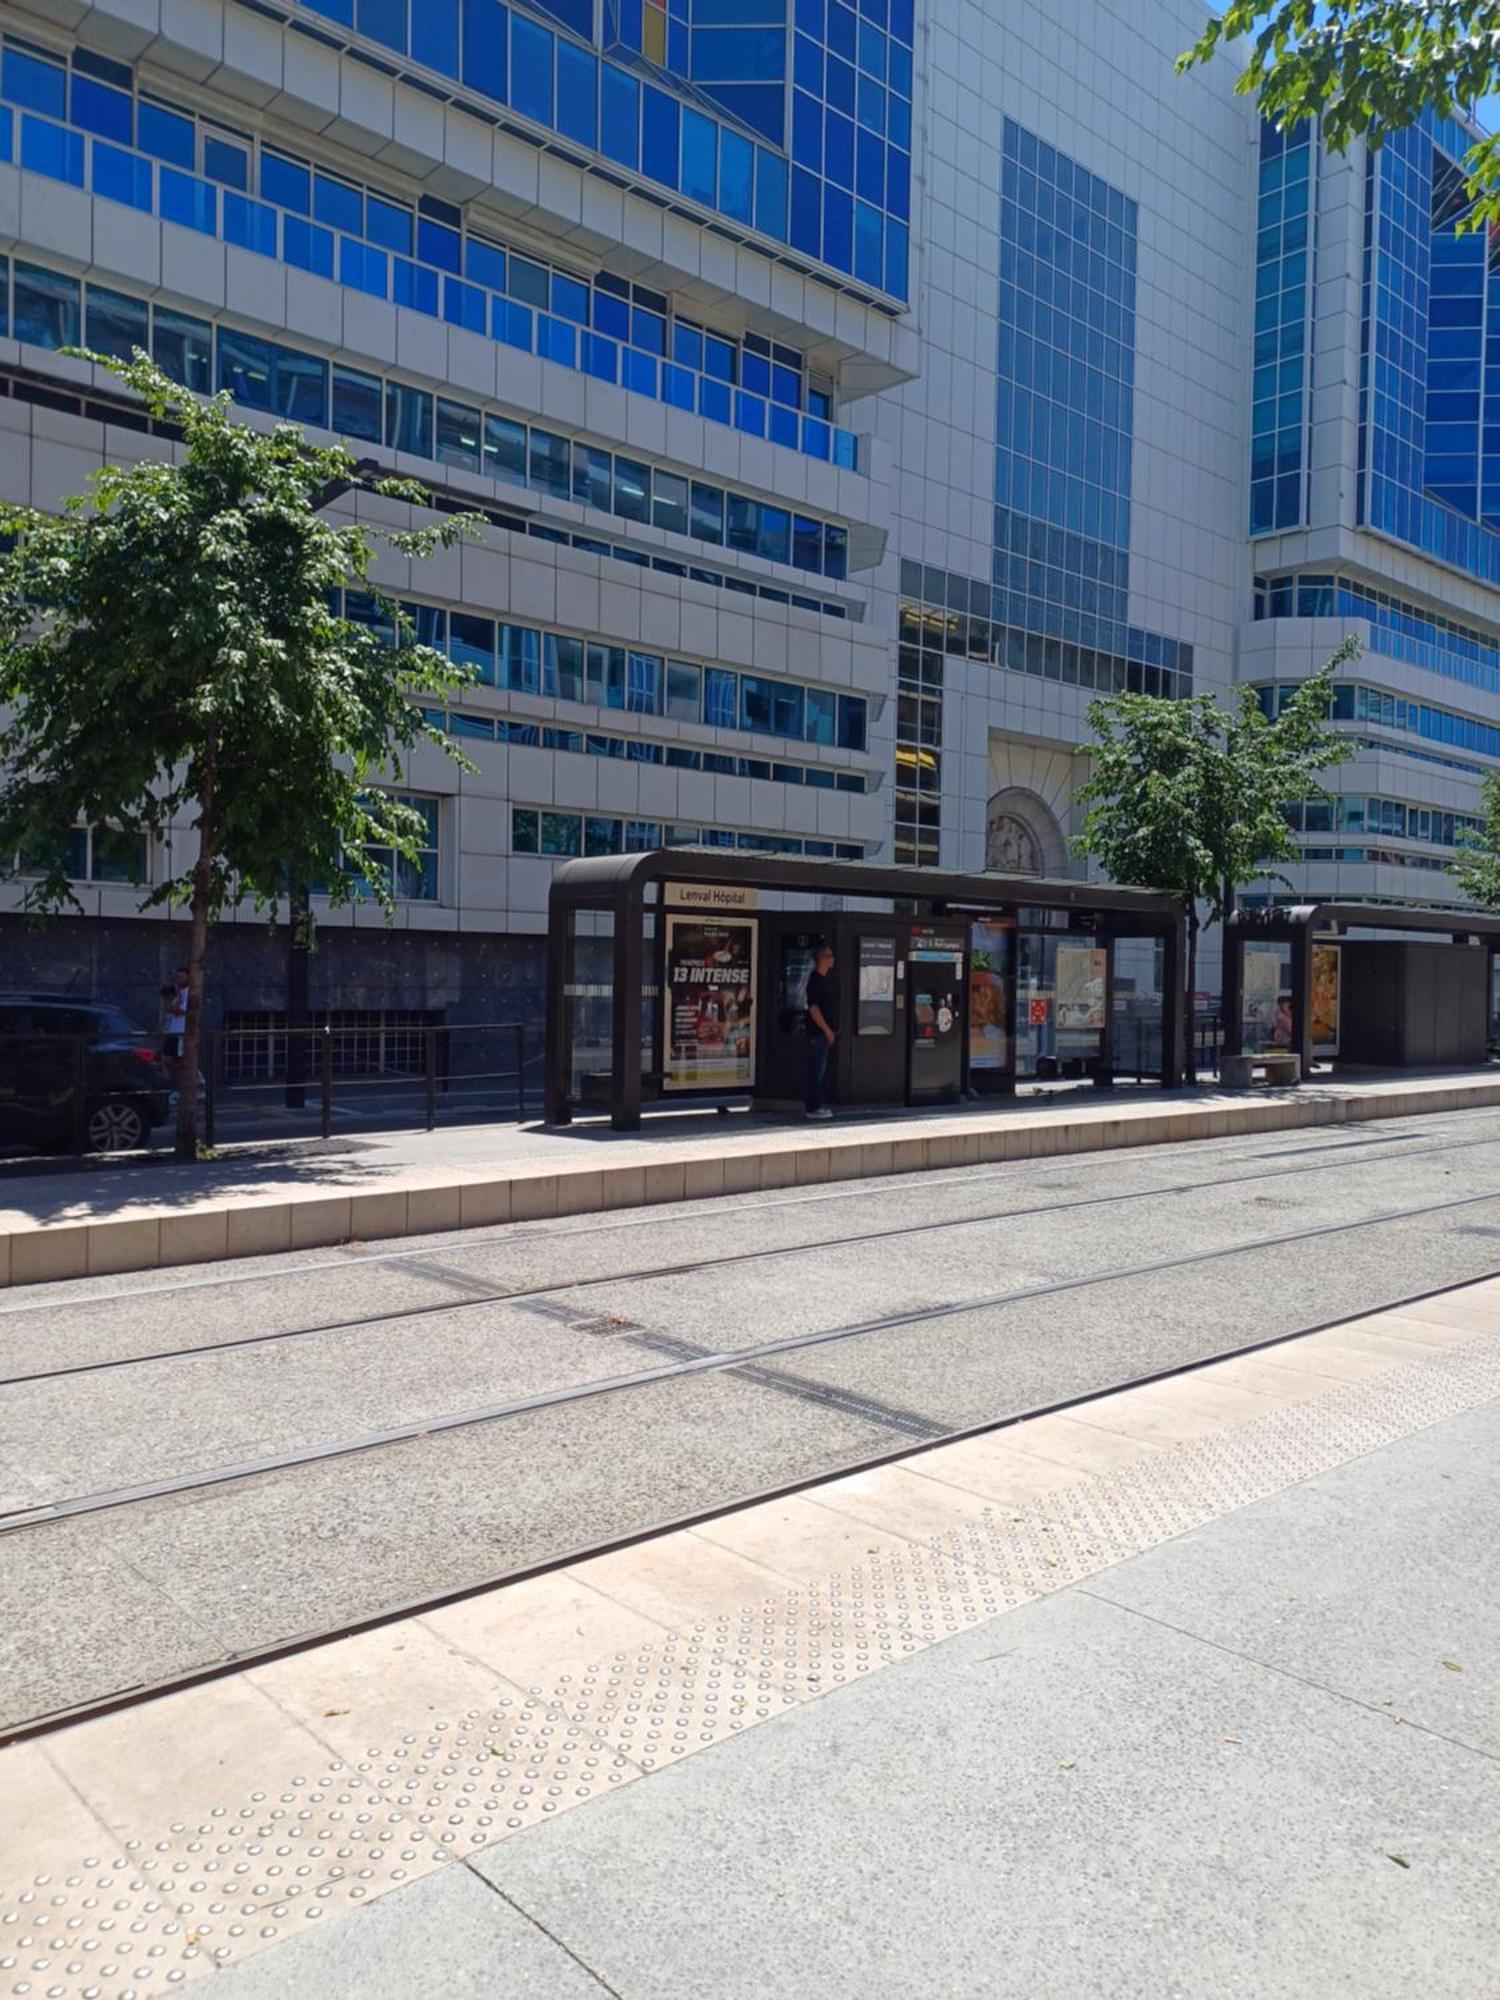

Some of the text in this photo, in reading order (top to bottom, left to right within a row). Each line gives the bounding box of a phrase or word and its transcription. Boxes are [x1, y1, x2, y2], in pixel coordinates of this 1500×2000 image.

[680, 888, 711, 903] Lenval
[673, 967, 749, 983] 13 INTENSE
